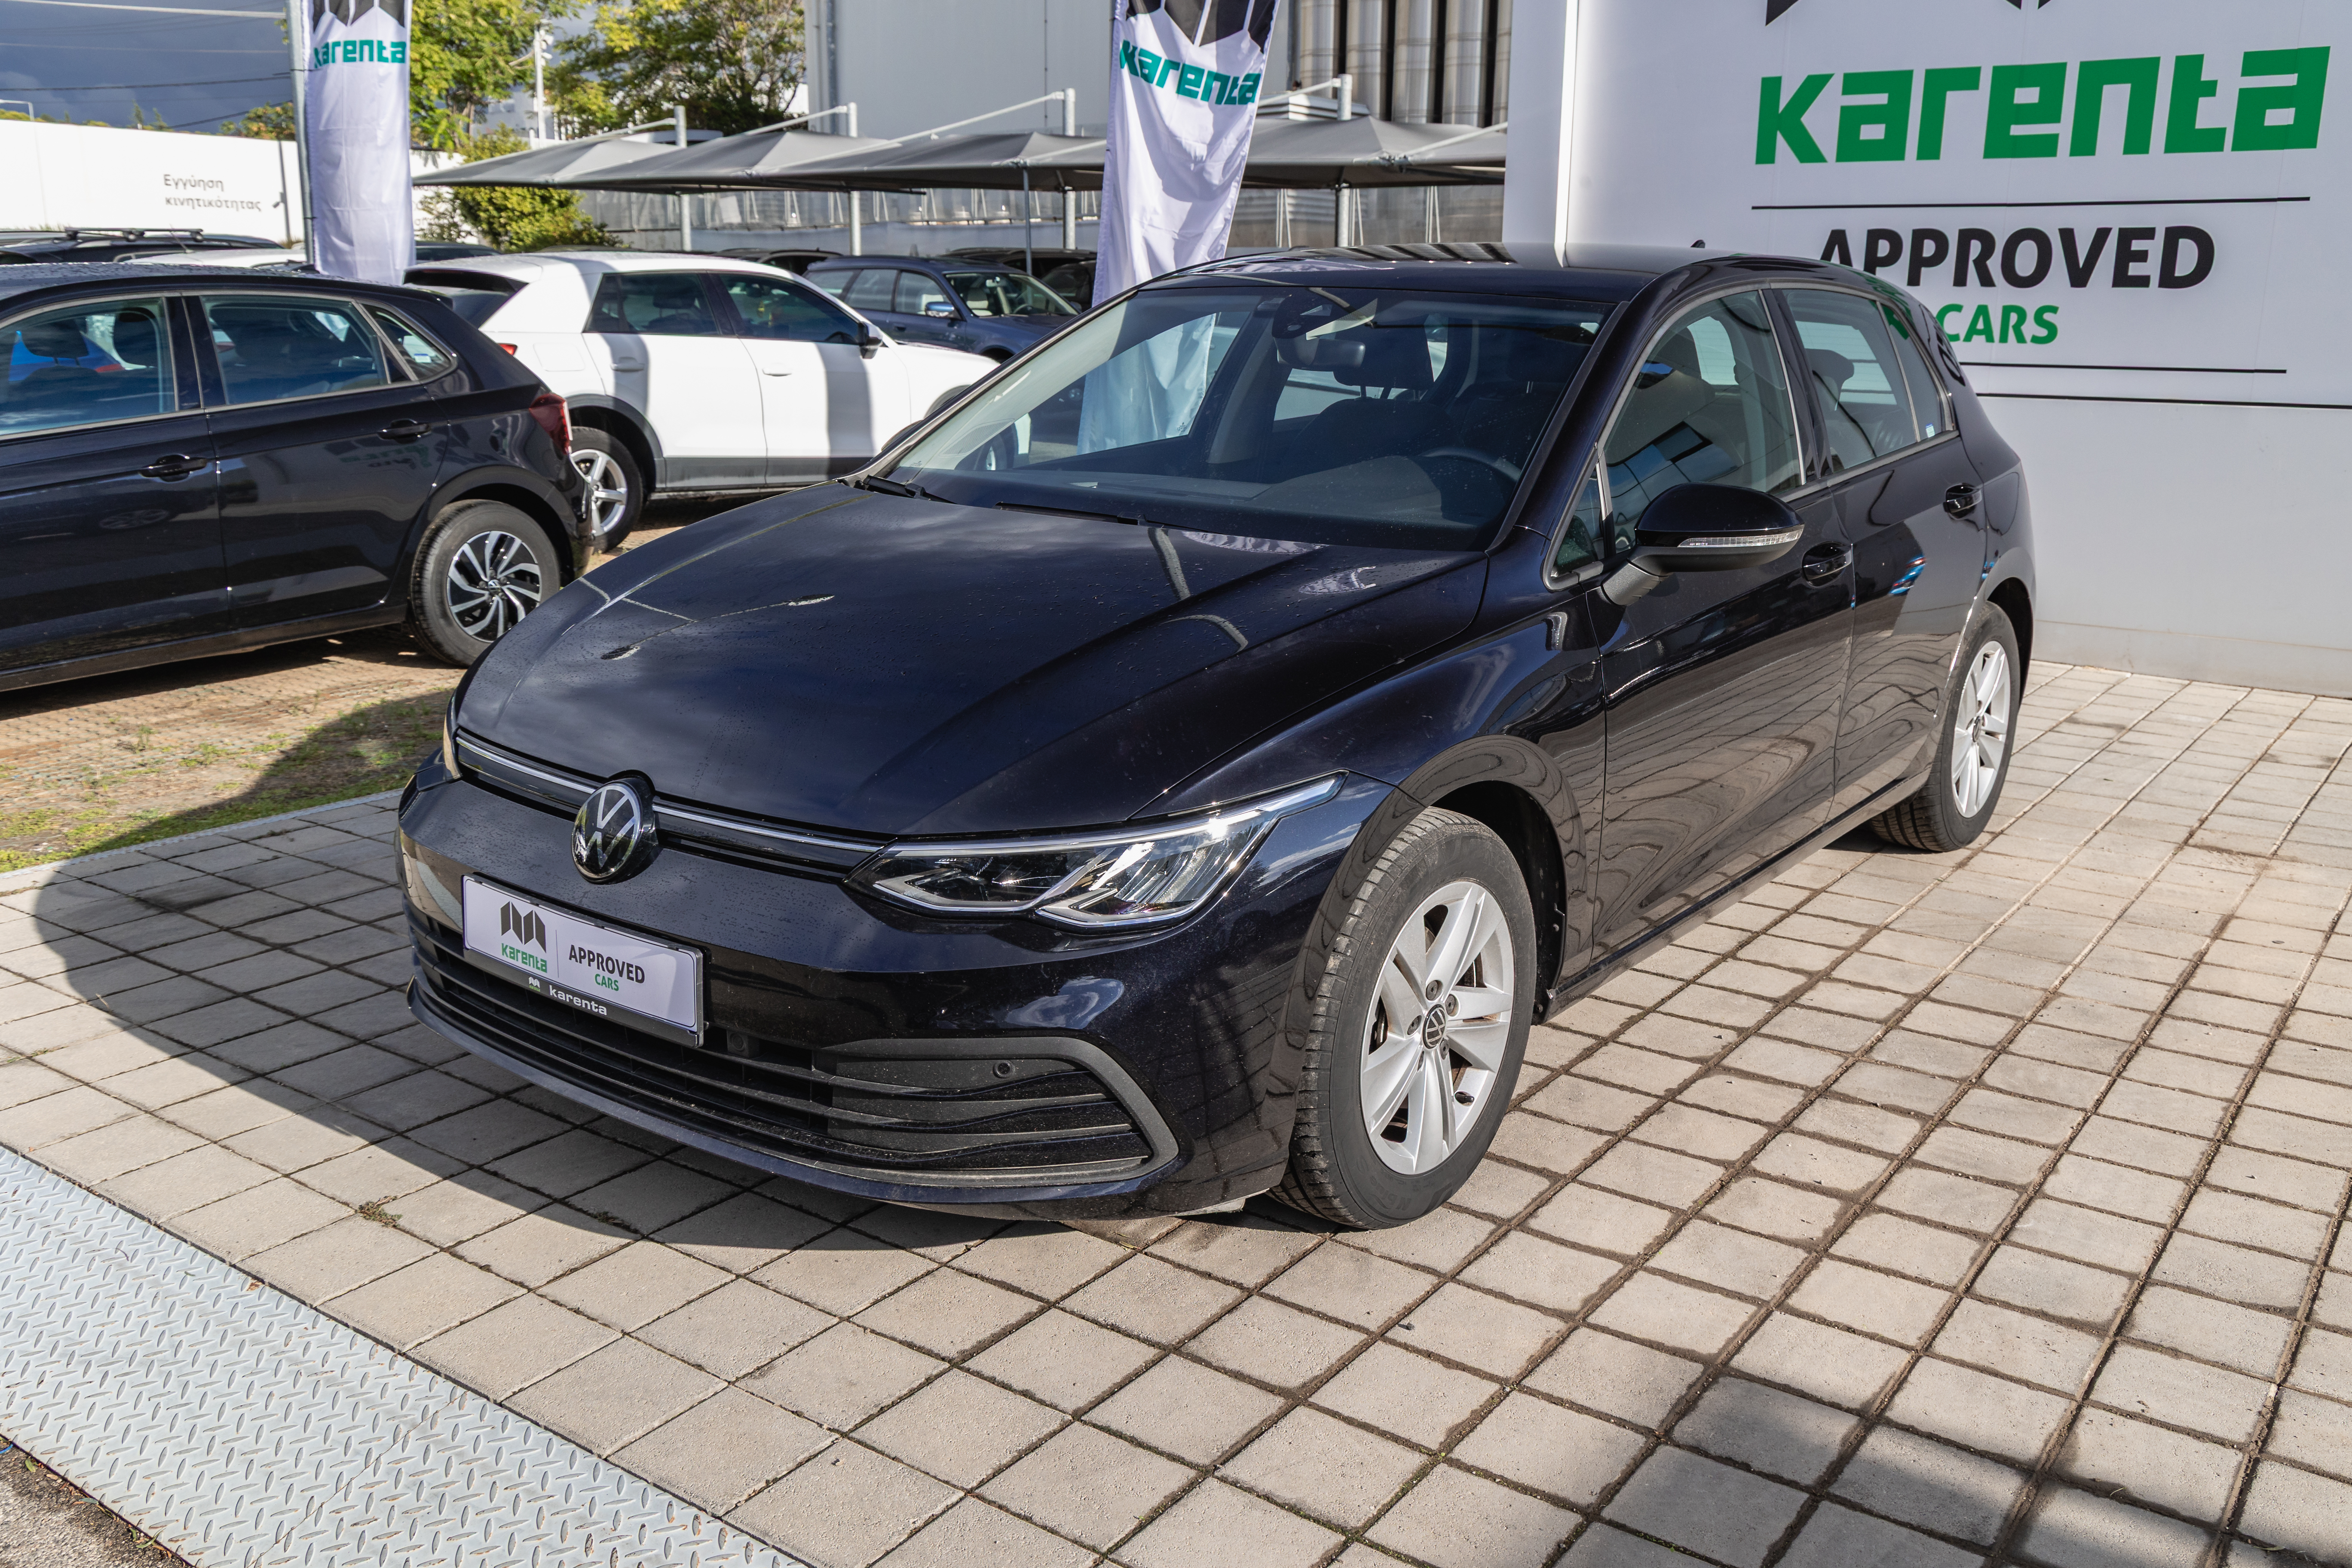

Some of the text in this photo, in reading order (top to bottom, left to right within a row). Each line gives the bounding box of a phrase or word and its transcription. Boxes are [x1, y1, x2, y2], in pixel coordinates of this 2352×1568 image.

[1755, 46, 2331, 165] karenta
[164, 174, 224, 192] Εγγύηση
[165, 196, 261, 211] κινητικότητας
[1819, 226, 2215, 288] APPROVED
[1936, 303, 2059, 344] CARS
[569, 944, 645, 983] APPROVED
[595, 974, 619, 991] CARS
[549, 985, 607, 1015] karenta
